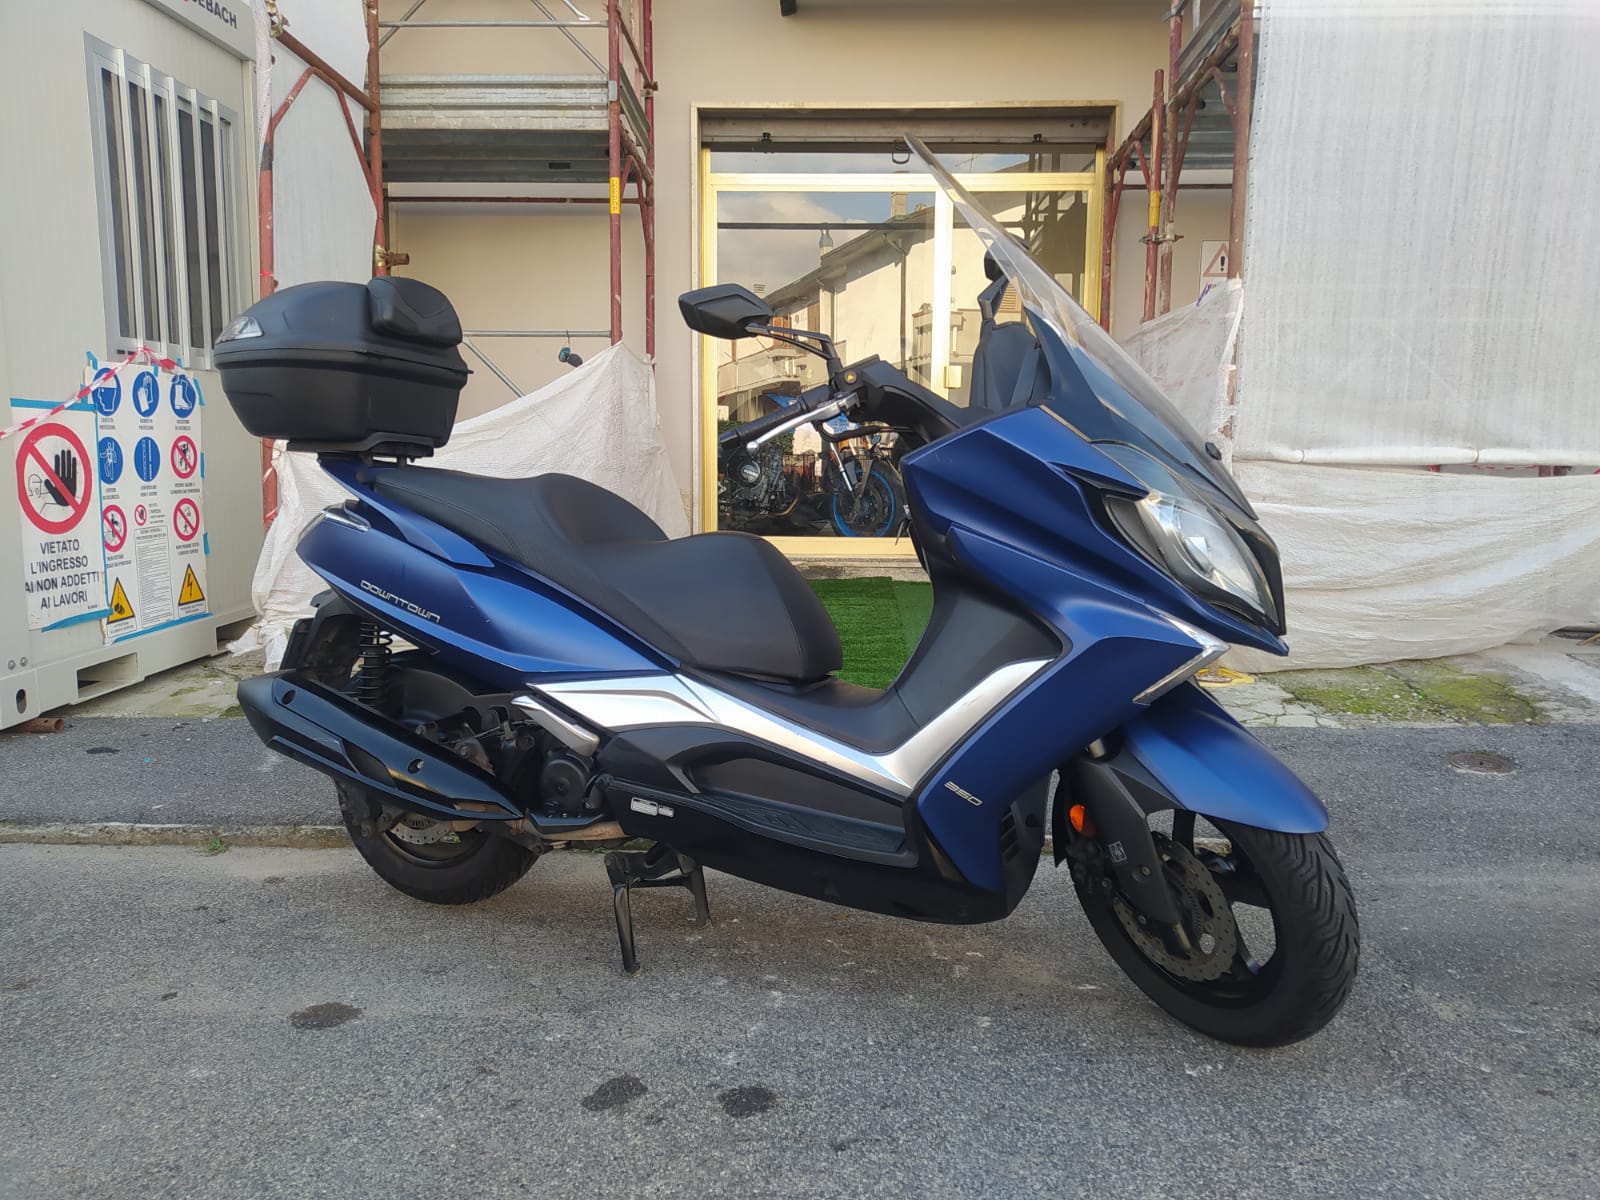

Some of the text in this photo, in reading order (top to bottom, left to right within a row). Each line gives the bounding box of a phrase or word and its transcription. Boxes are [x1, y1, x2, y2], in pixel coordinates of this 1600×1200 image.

[40, 539, 80, 554] VIETATO
[30, 555, 89, 575] L'INGRESSO
[25, 571, 100, 593] AI NON ADDETTI
[41, 590, 88, 610] AI LAVORI
[360, 579, 441, 624] DOWNTOWN
[944, 780, 983, 807] 350
